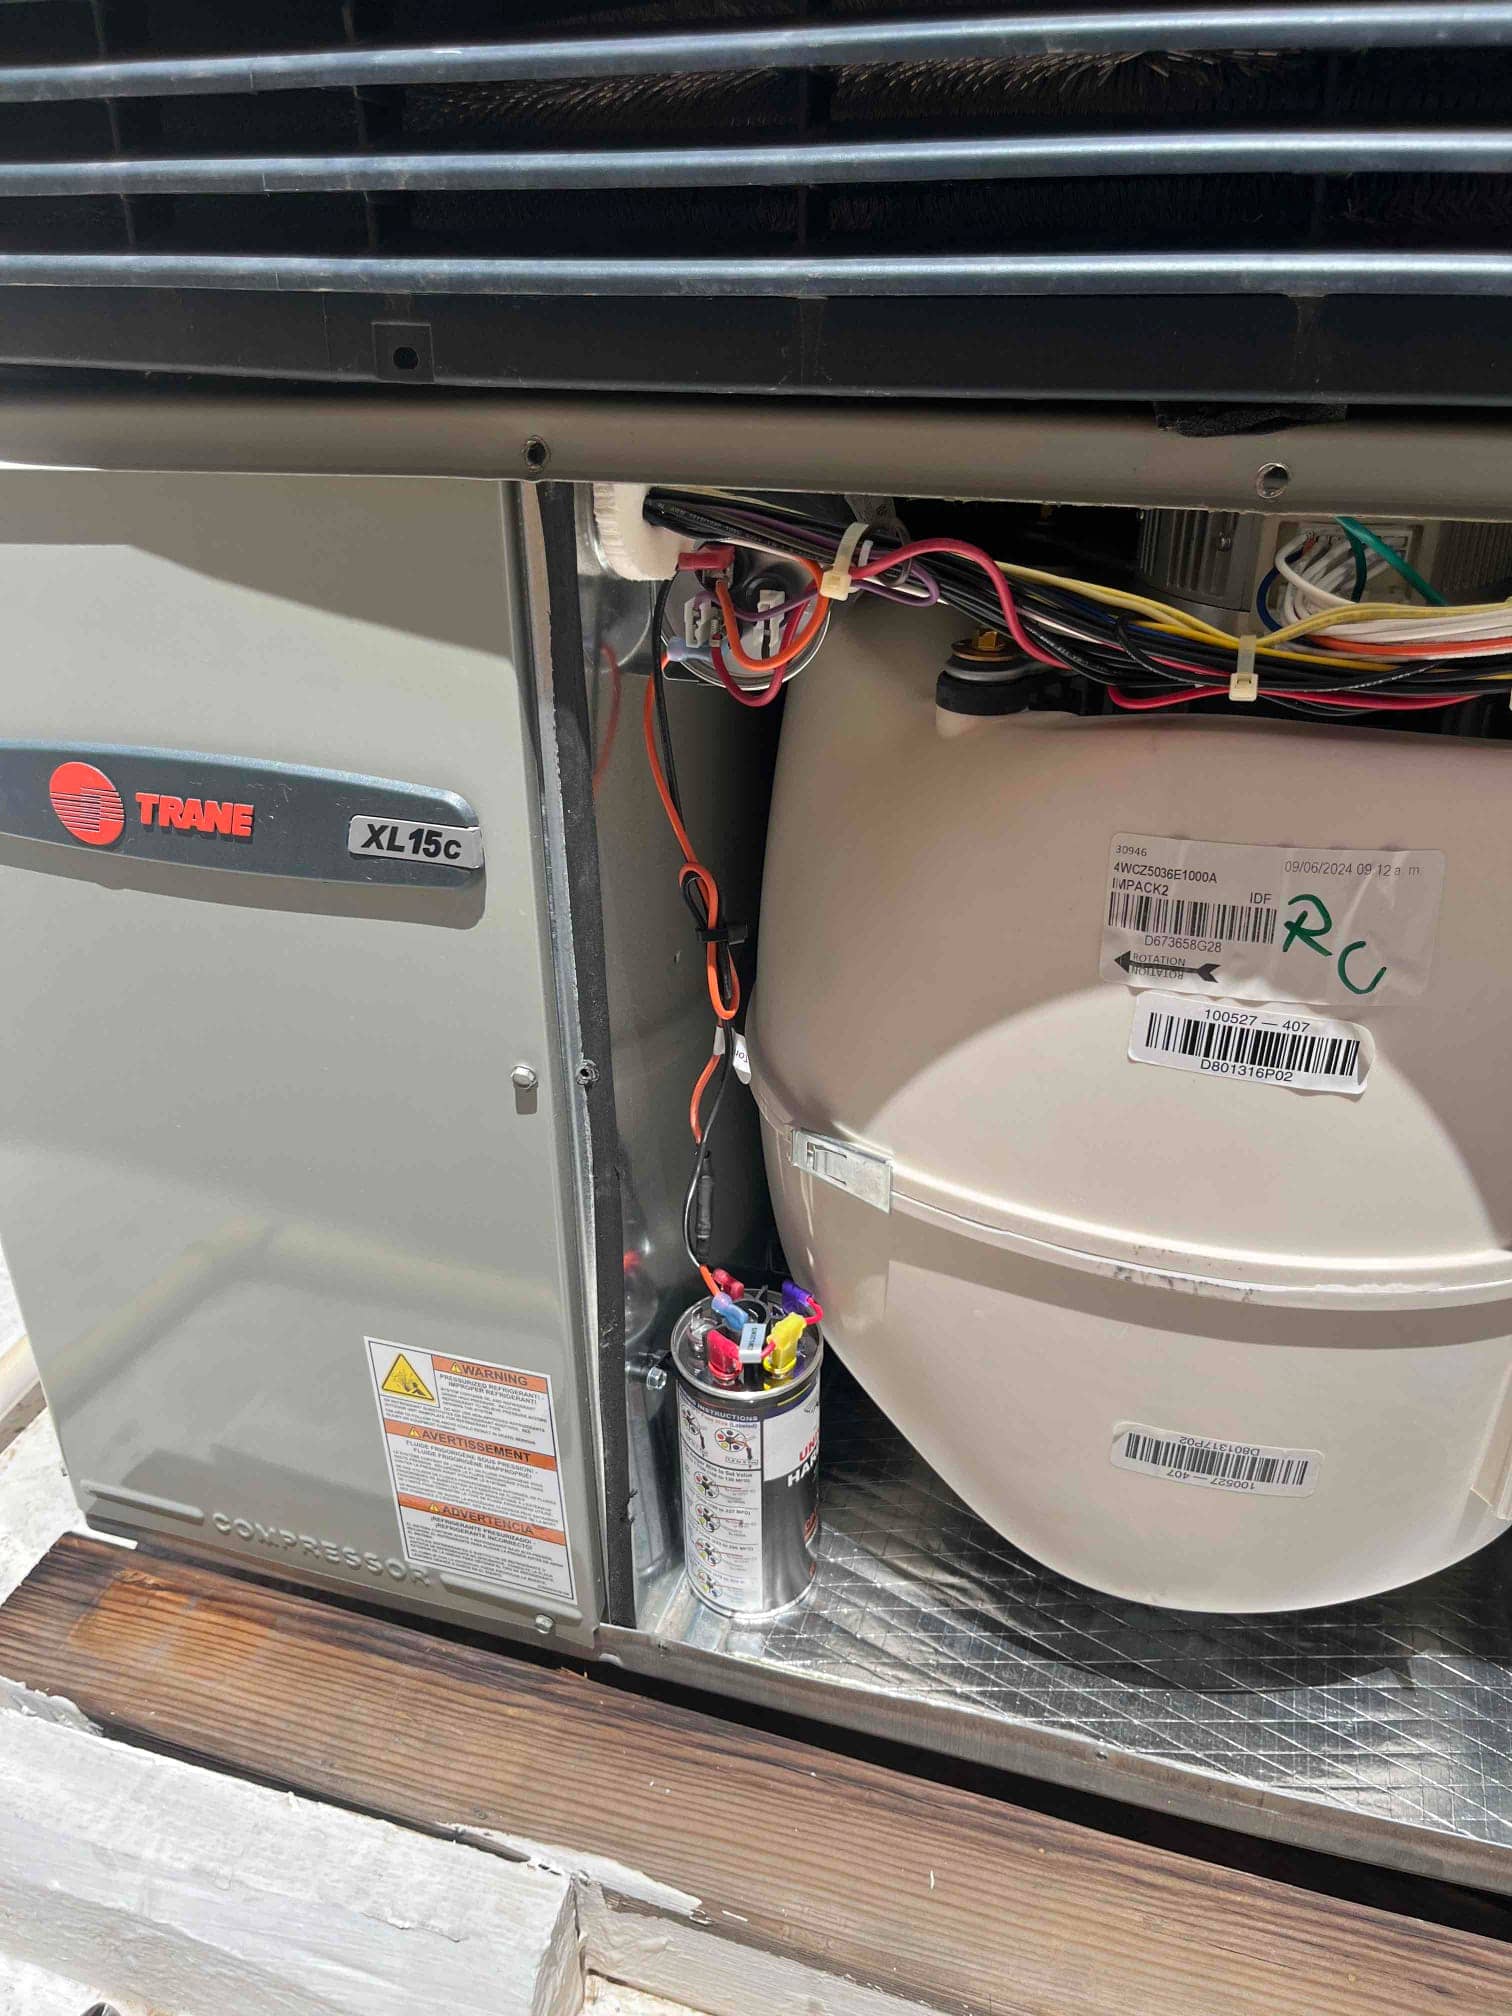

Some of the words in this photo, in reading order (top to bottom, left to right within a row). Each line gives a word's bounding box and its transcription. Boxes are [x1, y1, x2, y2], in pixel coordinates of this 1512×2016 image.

[134, 792, 256, 838] TRANE
[1115, 844, 1148, 857] 30946
[1113, 862, 1218, 884] 4WCZ5036E1000A
[1284, 860, 1353, 875] 09/06/2024
[1112, 877, 1169, 897] IMPACK2
[1250, 892, 1273, 905] IDF
[1144, 934, 1222, 954] D673658G28
[1132, 952, 1186, 967] ROTATION
[1205, 1009, 1258, 1026] 100527
[1282, 1020, 1311, 1033] 407
[1200, 1059, 1294, 1082] D801316P02
[440, 1373, 488, 1389] PRESSURIZED
[461, 1364, 528, 1387] WARNING
[697, 1403, 759, 1422] INSTRUCTIONS
[422, 1429, 531, 1462] AVERTISSEMENT
[1180, 1436, 1260, 1457] D801317P02
[1167, 1469, 1190, 1479] 407
[1210, 1478, 1256, 1490] 100527
[442, 1505, 534, 1535] ADVERTENCIA
[212, 1511, 433, 1588] COMPRESSOR
